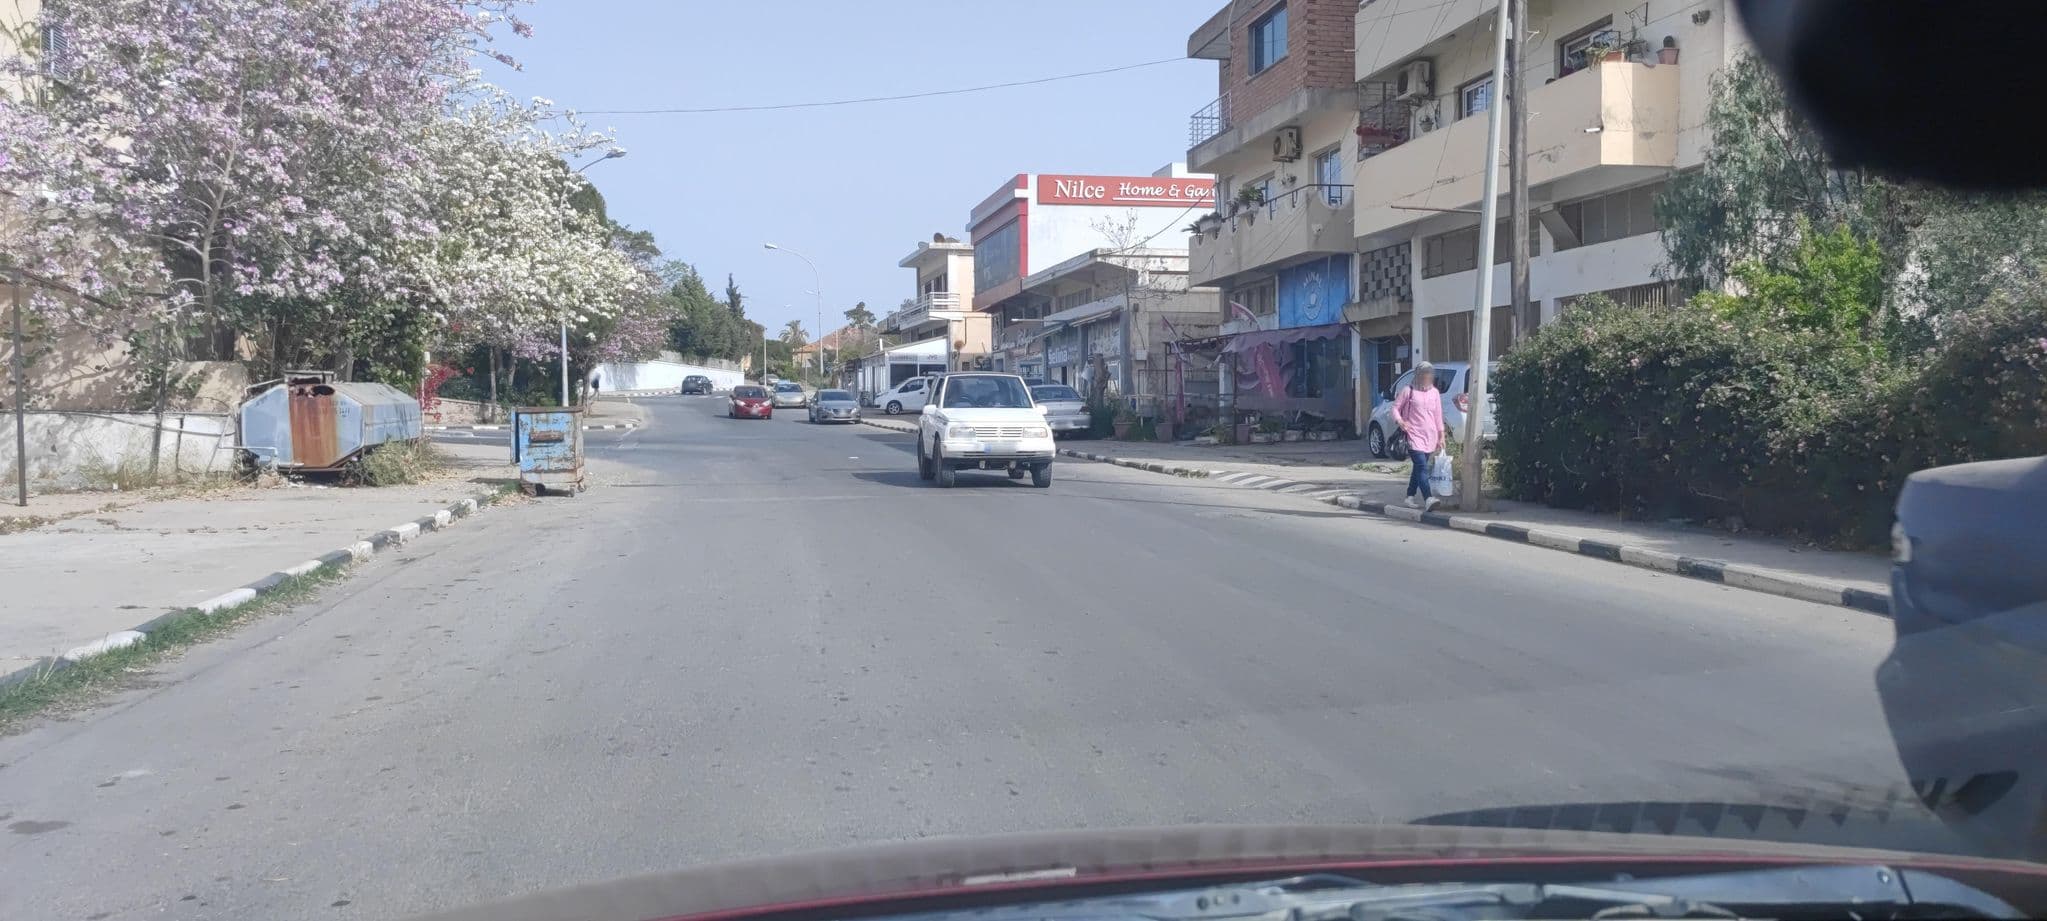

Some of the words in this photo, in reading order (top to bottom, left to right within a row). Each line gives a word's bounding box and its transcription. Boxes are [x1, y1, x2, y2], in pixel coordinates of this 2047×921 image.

[1054, 179, 1105, 199] Nilce
[1119, 181, 1166, 196] Home
[1168, 184, 1181, 198] &
